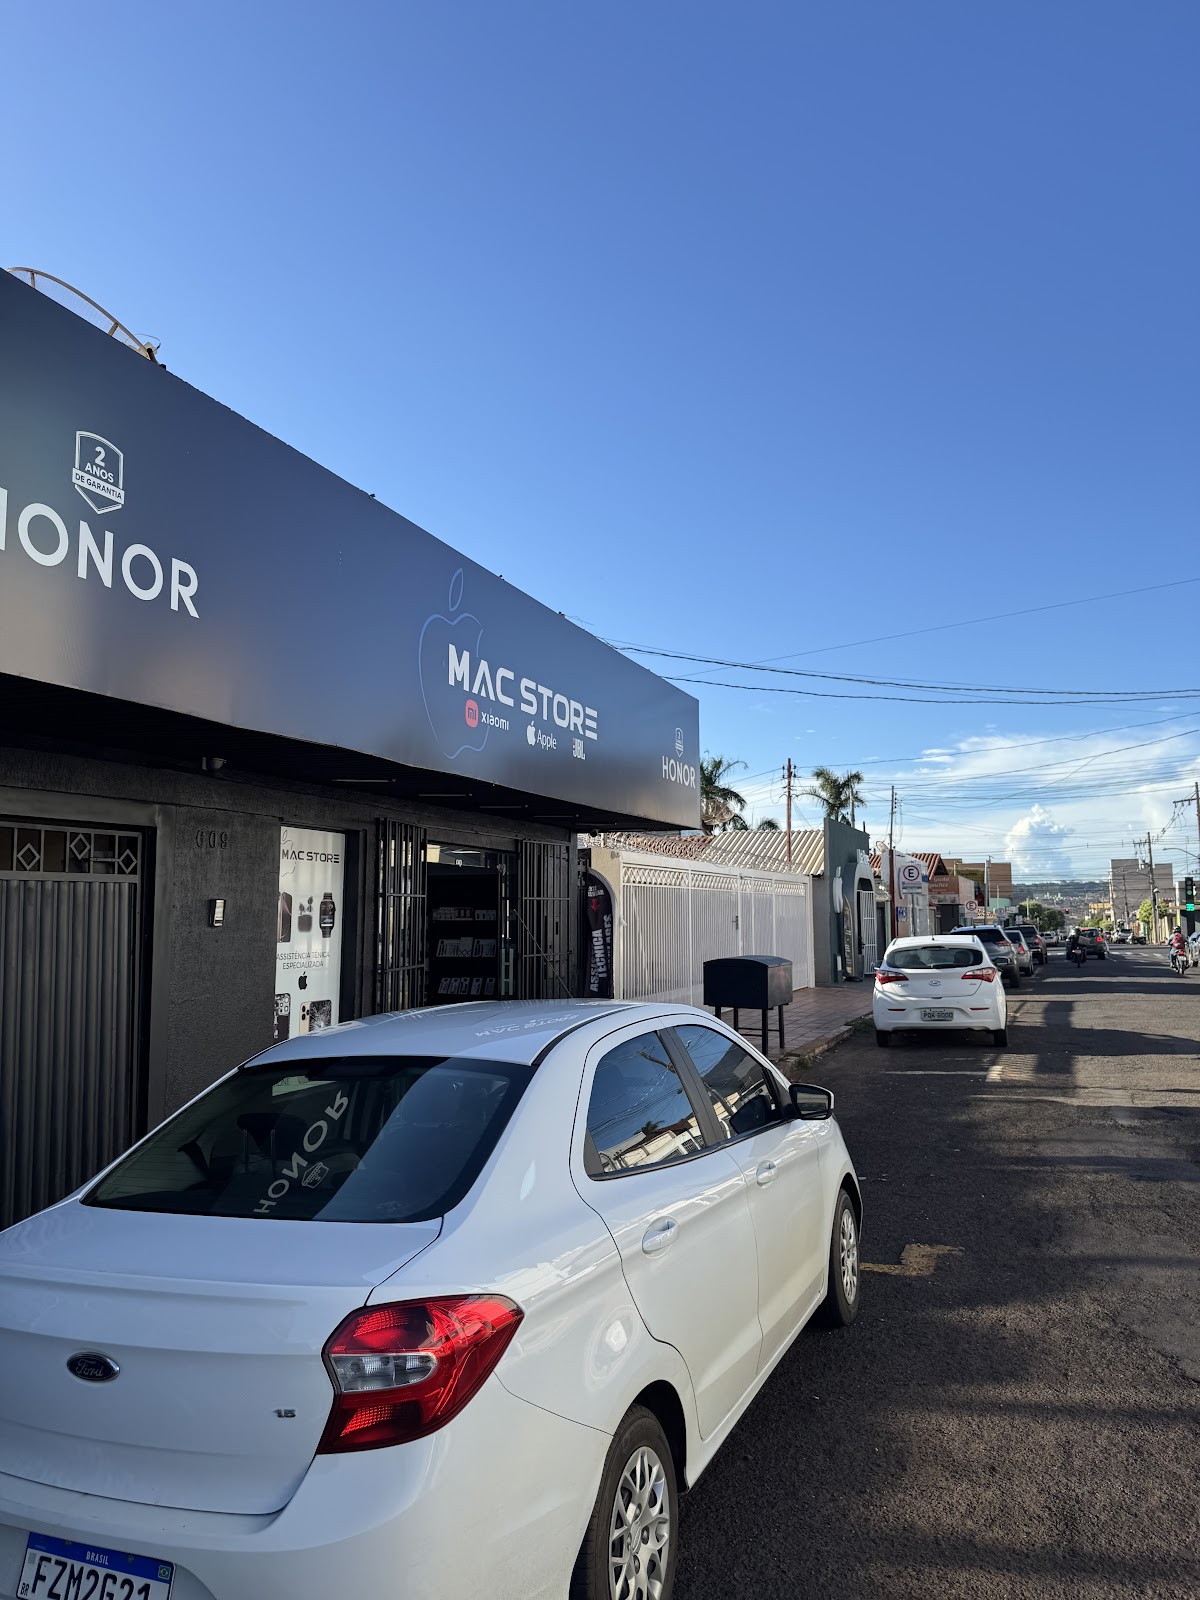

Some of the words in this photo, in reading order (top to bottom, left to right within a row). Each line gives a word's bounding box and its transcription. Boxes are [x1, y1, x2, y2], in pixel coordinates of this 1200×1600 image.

[95, 446, 106, 467] 2
[85, 462, 114, 483] ANOS
[75, 473, 86, 484] DE
[86, 478, 123, 500] GARANTIA
[0, 487, 199, 618] ONOR
[449, 643, 514, 707] MAC
[520, 677, 598, 740] STORE
[537, 729, 557, 750] Apple
[572, 738, 586, 760] JBL
[662, 755, 696, 789] HONOR
[281, 849, 305, 861] MAC
[306, 851, 340, 864] STORE
[908, 868, 915, 878] E
[282, 960, 324, 970] ESPECIALIZADA
[75, 1358, 105, 1378] Ford
[86, 1550, 109, 1565] BRASIL
[20, 1582, 30, 1597] BR
